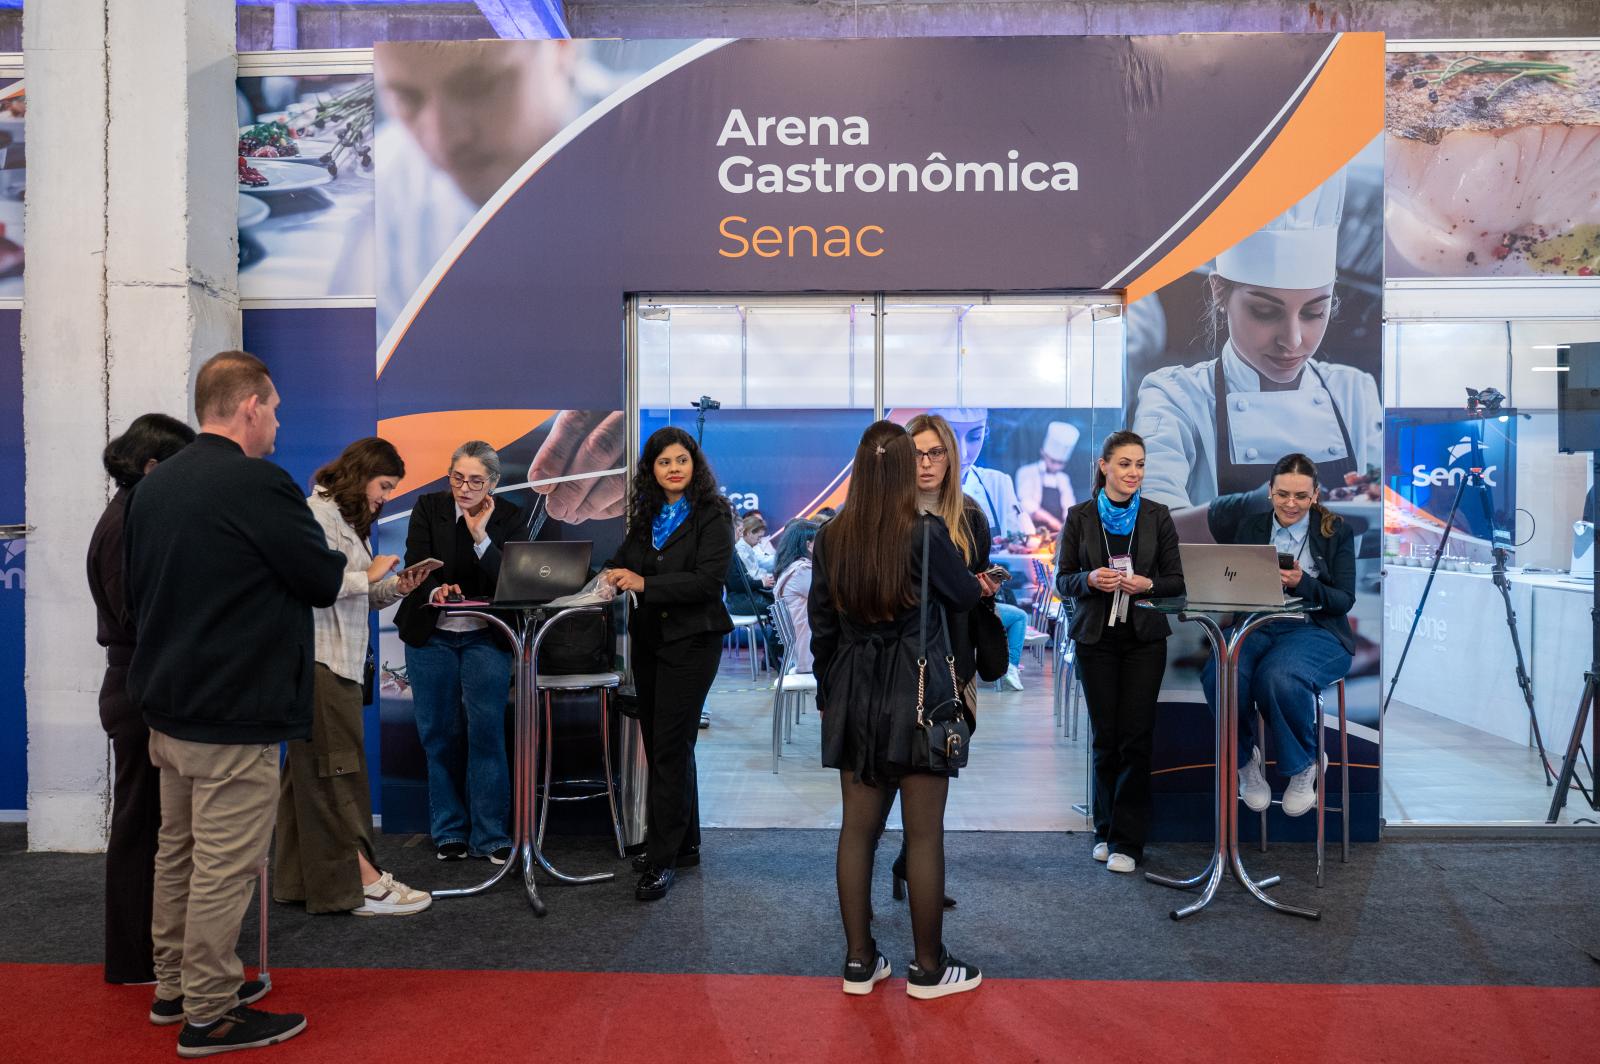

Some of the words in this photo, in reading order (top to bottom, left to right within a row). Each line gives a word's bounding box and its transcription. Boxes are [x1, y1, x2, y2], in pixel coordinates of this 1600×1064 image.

[716, 108, 870, 146] Arena
[717, 149, 1080, 194] Gastronômica
[718, 215, 885, 258] Senac
[1412, 464, 1497, 487] Senc
